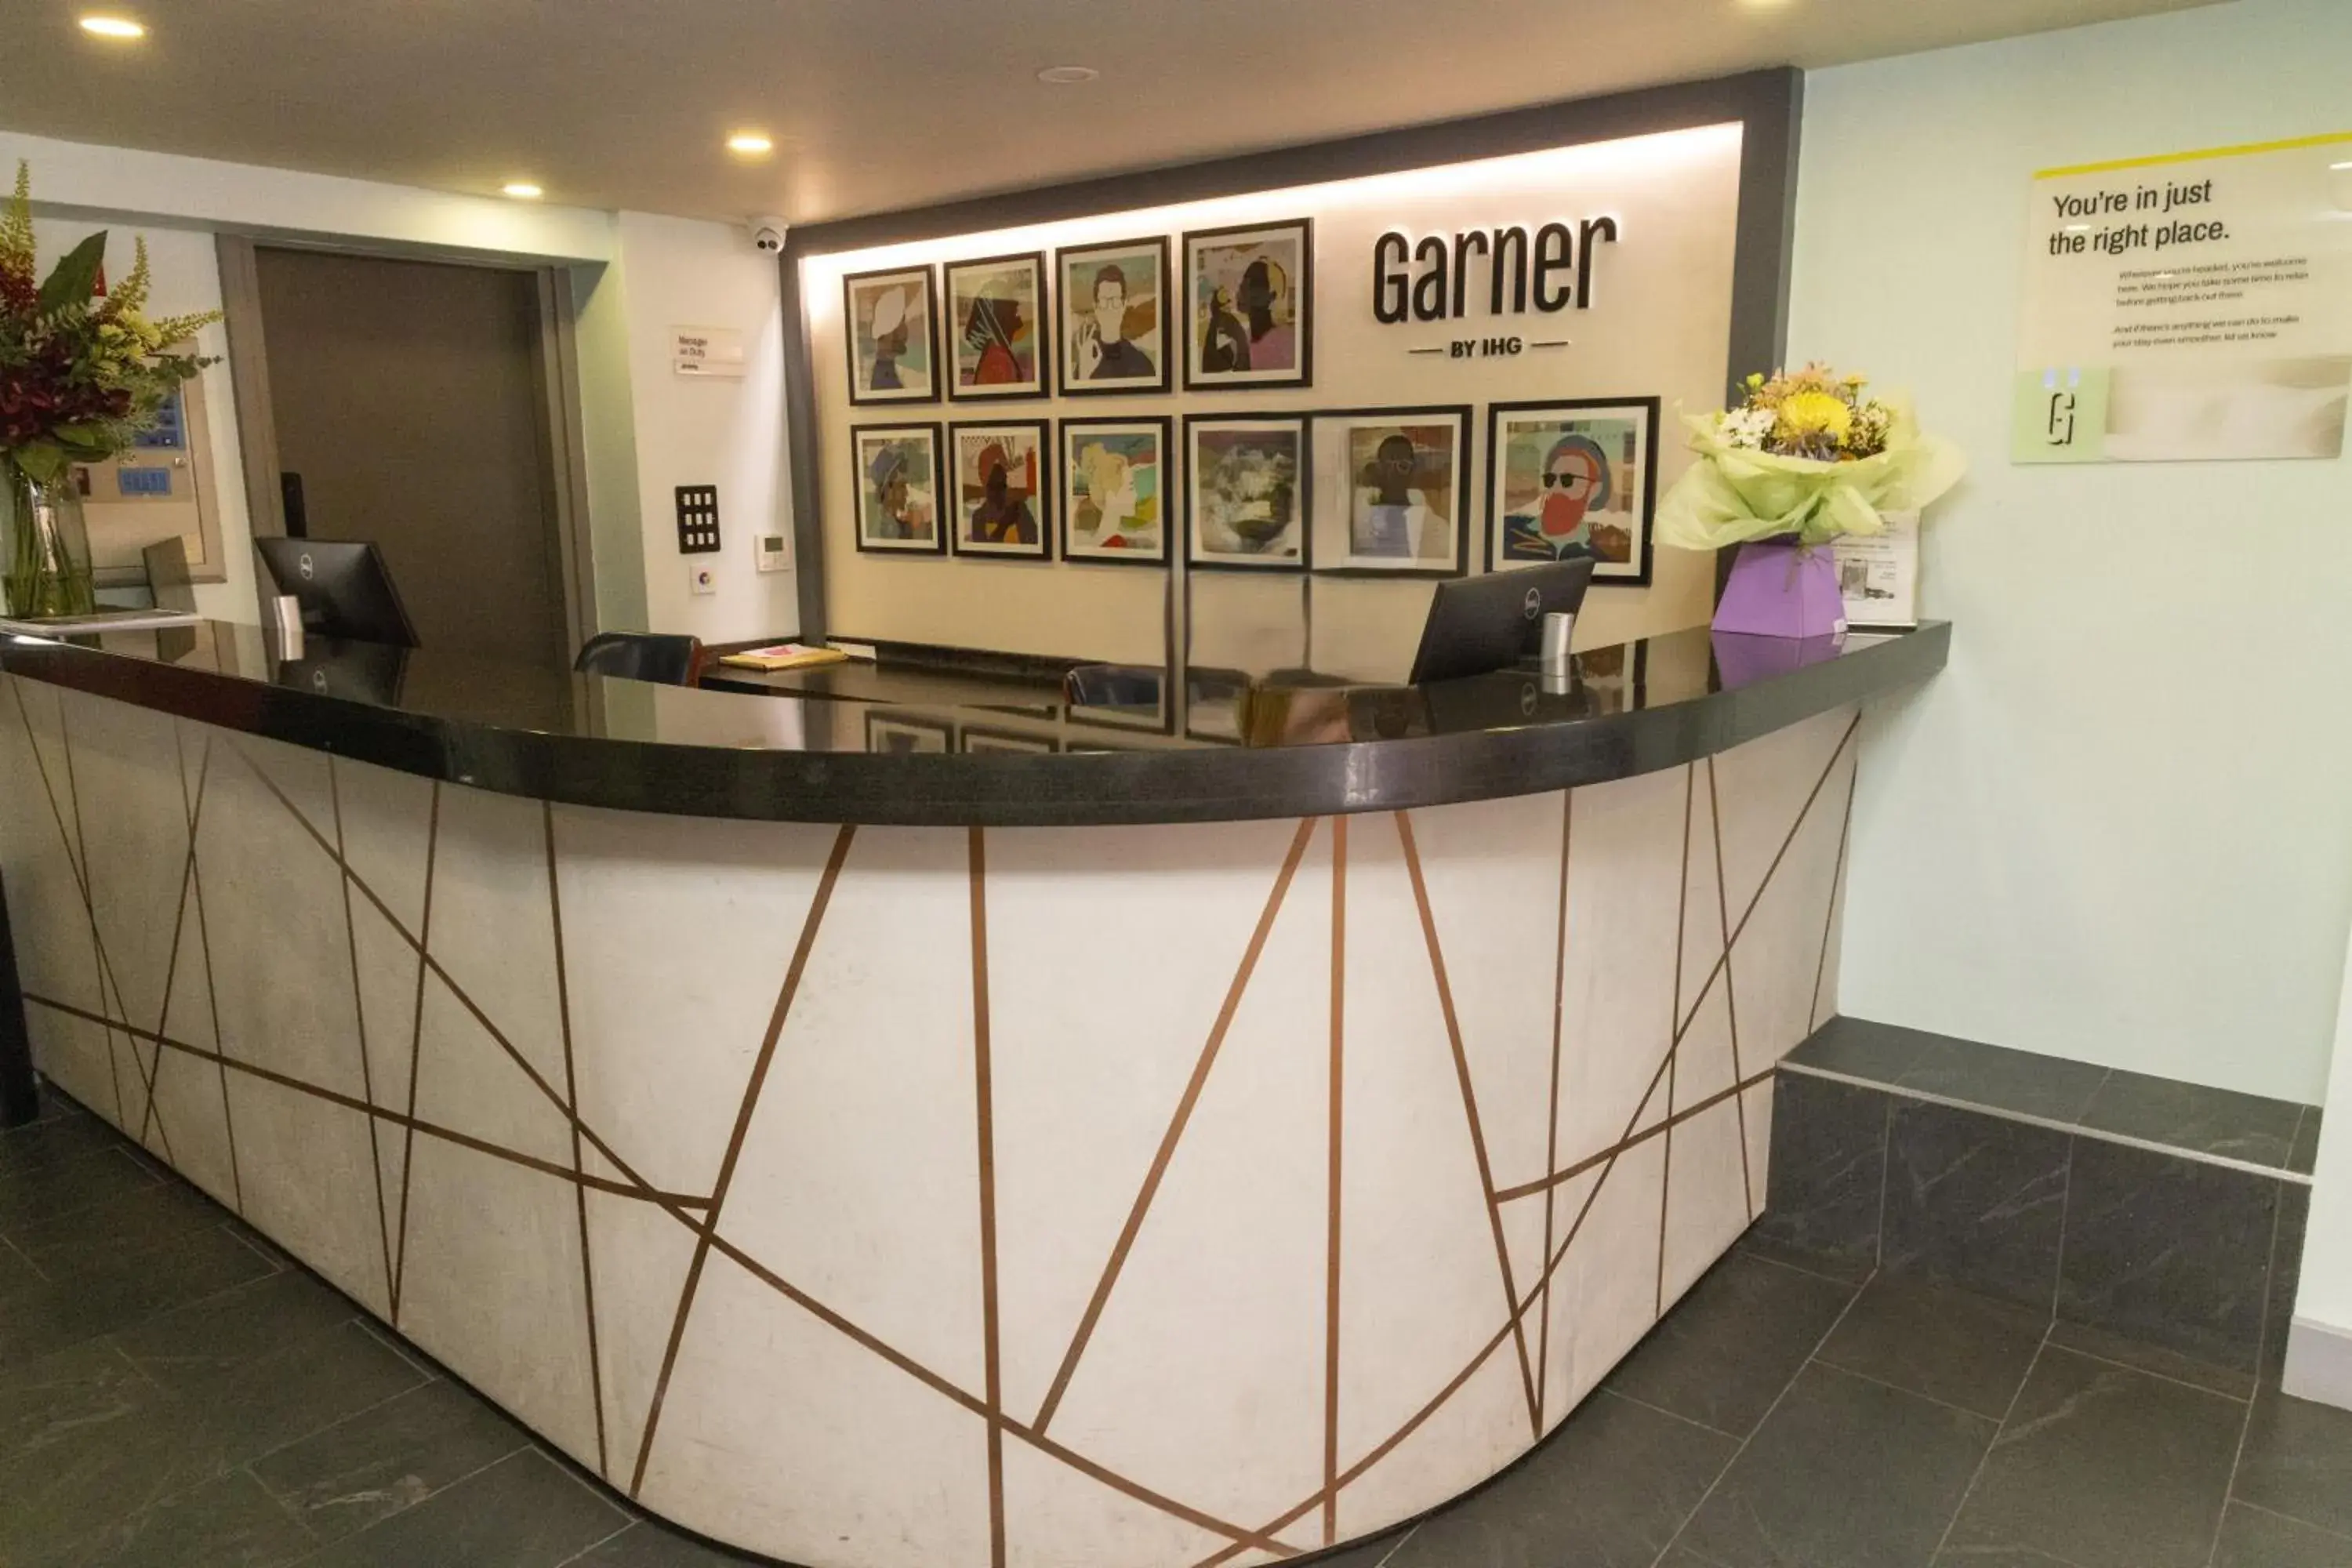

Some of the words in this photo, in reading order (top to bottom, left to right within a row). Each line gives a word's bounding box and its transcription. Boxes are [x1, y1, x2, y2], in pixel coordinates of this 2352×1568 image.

[2053, 191, 2128, 217] You're
[2136, 185, 2158, 210] in
[2162, 179, 2212, 212] just
[2049, 231, 2085, 255] the
[2093, 223, 2150, 255] right
[2155, 220, 2230, 251] place.
[1374, 216, 1617, 324] Garner
[2141, 283, 2156, 292] We
[2158, 281, 2181, 292] hope
[2183, 280, 2200, 289] you
[1450, 340, 1476, 358] BY
[1483, 336, 1523, 358] IHG
